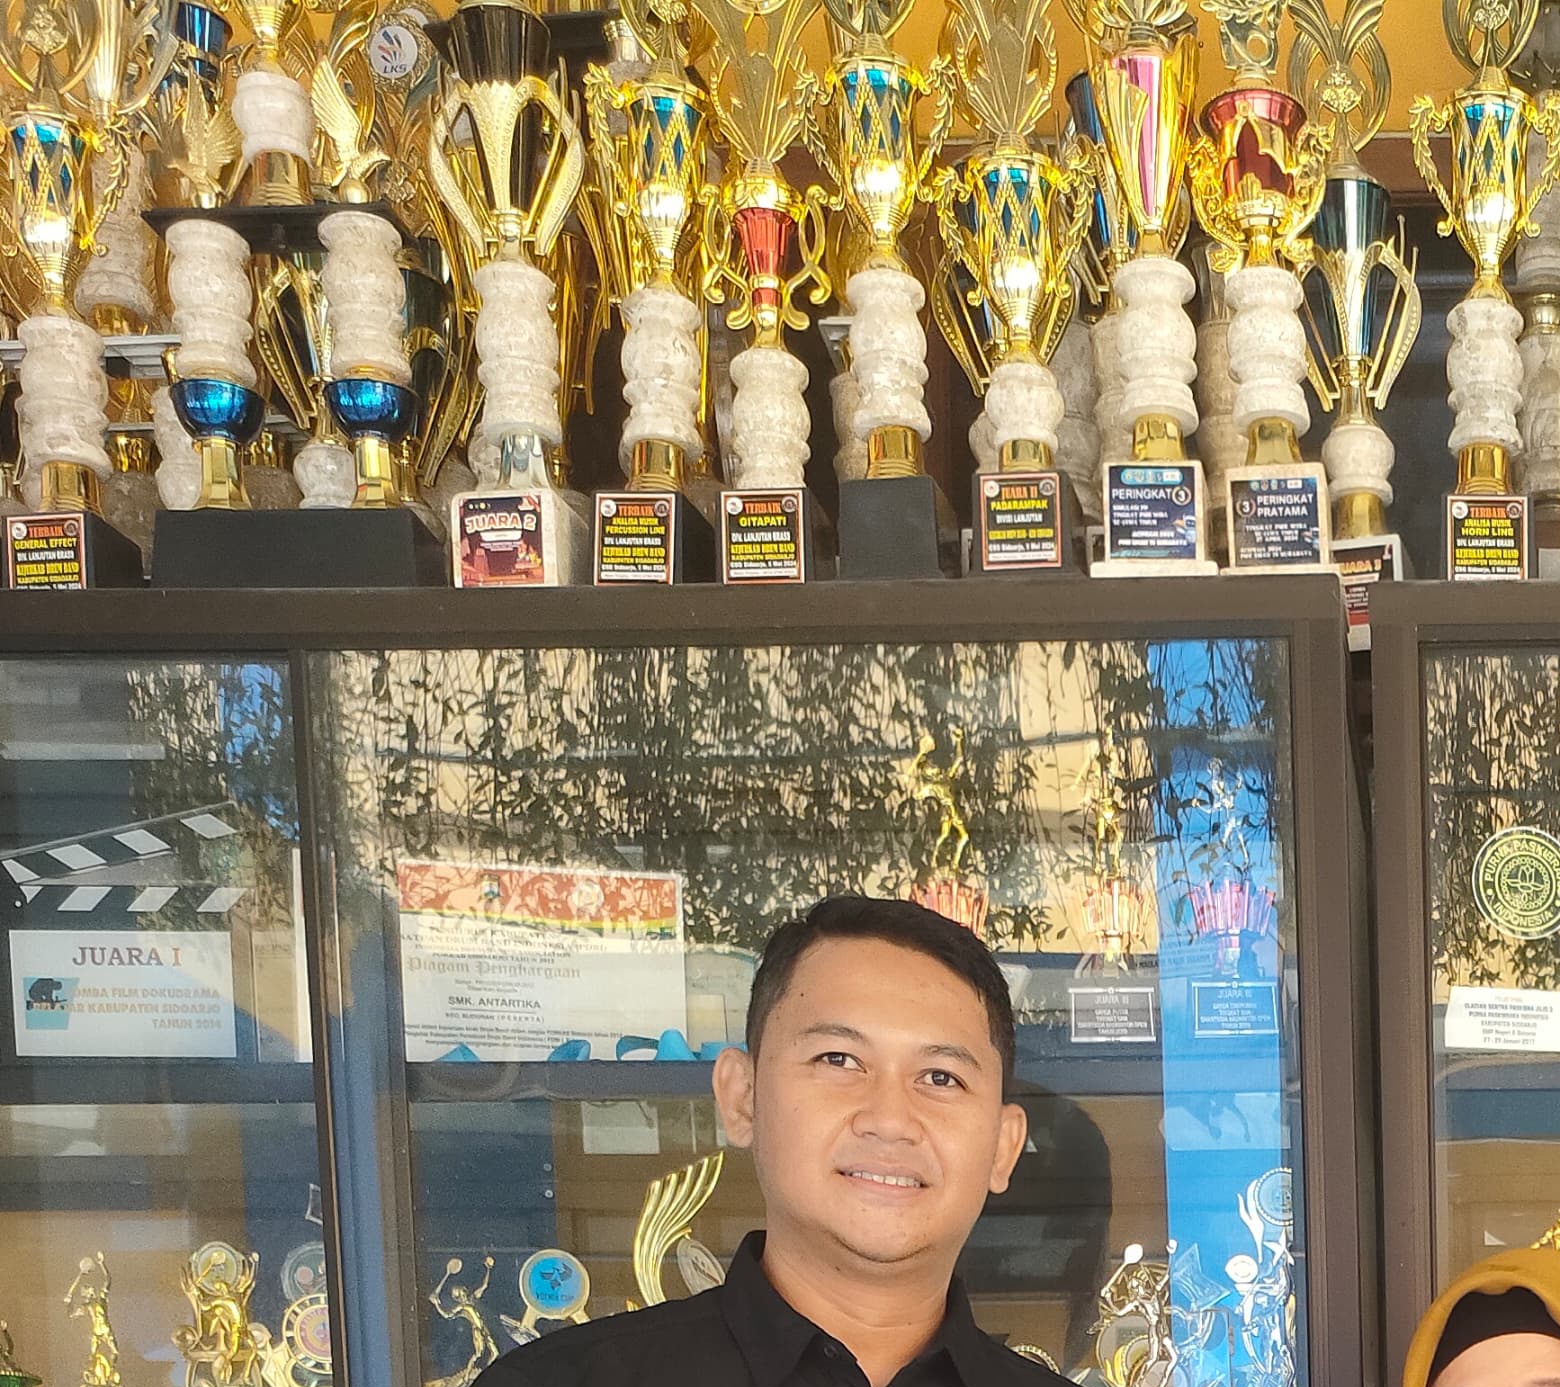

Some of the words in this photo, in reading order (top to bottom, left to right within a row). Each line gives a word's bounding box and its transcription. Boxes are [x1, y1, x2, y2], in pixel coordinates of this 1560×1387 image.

[383, 64, 407, 73] LKS
[1002, 486, 1028, 500] JUARA
[1112, 488, 1173, 500] PERINGKAT
[1178, 490, 1186, 502] 3
[744, 502, 782, 514] TERBAIK
[1242, 501, 1250, 513] 3
[1257, 494, 1313, 505] PERINGKAT
[618, 505, 654, 516] TERBAIK
[1257, 506, 1308, 518] PRATAMA
[1470, 507, 1507, 518] TERBAIK
[464, 512, 522, 534] JUARA
[523, 513, 537, 531] 2
[29, 526, 64, 537] TERBAIK
[605, 526, 648, 534] PERCUSSION
[649, 526, 665, 535] LINE
[1461, 528, 1489, 536] HORN
[1492, 528, 1514, 536] LINE
[15, 539, 48, 550] GENERAL
[49, 538, 77, 548] EFFECT
[1339, 560, 1372, 574] UARA
[1484, 842, 1513, 881] PURNA
[1493, 903, 1554, 927] INDONESIA
[72, 946, 163, 966] JUARA
[171, 946, 182, 966] I
[408, 957, 469, 973] Piagam
[476, 960, 581, 979] Penghargaan
[72, 987, 108, 999] OMBA
[111, 987, 139, 998] FILM
[141, 987, 220, 999] DOKUDRAMA
[87, 1002, 159, 1014] KABUPATEN
[162, 1002, 221, 1014] SIDOARJO
[448, 996, 475, 1006] SMK.
[478, 998, 542, 1009] ANTARTIKA
[152, 1019, 192, 1029] TAHUN
